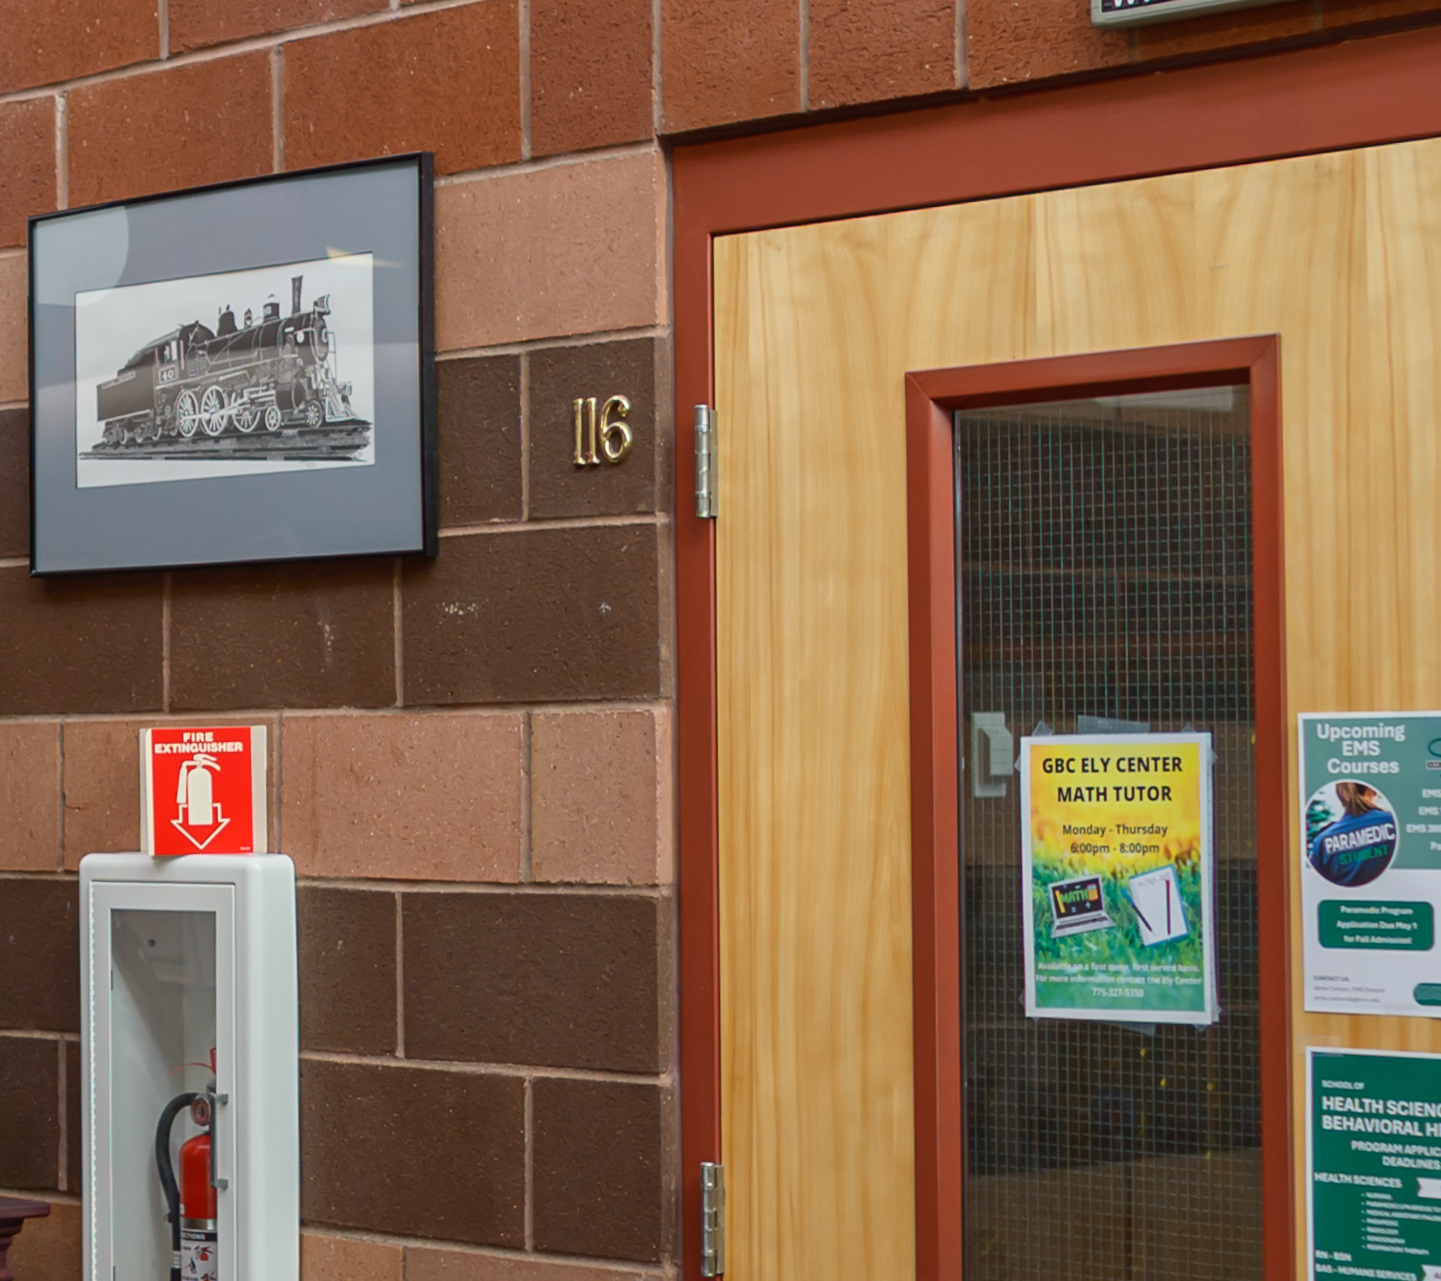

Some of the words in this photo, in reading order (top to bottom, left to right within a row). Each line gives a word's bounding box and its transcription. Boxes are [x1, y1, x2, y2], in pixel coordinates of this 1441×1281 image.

[572, 394, 633, 465] 116
[183, 732, 214, 743] FIRE
[1317, 722, 1406, 742] Upcoming
[154, 742, 244, 754] EXTINGUISHER
[1342, 740, 1381, 756] EMS
[1042, 758, 1076, 773] GBC
[1081, 757, 1111, 773] ELY
[1116, 756, 1183, 772] CENTER
[1327, 758, 1400, 774] Courses
[1057, 786, 1108, 802] MATH
[1113, 786, 1173, 801] TUTOR
[1418, 806, 1439, 816] EMS
[1062, 824, 1106, 837] Monday
[1116, 824, 1168, 837] Thursday
[1324, 823, 1396, 853] PARAMEDIC
[1070, 843, 1110, 856] 6:00pm
[1119, 843, 1160, 856] 8:00pm
[1321, 1095, 1384, 1114] HEALTH
[1321, 1115, 1423, 1137] BEHAVIORAL
[1351, 1140, 1404, 1154] PROGRAM
[1382, 1156, 1441, 1170] DEADLINES
[1314, 1171, 1354, 1185] HEALTH
[1354, 1175, 1403, 1189] SCIENCES
